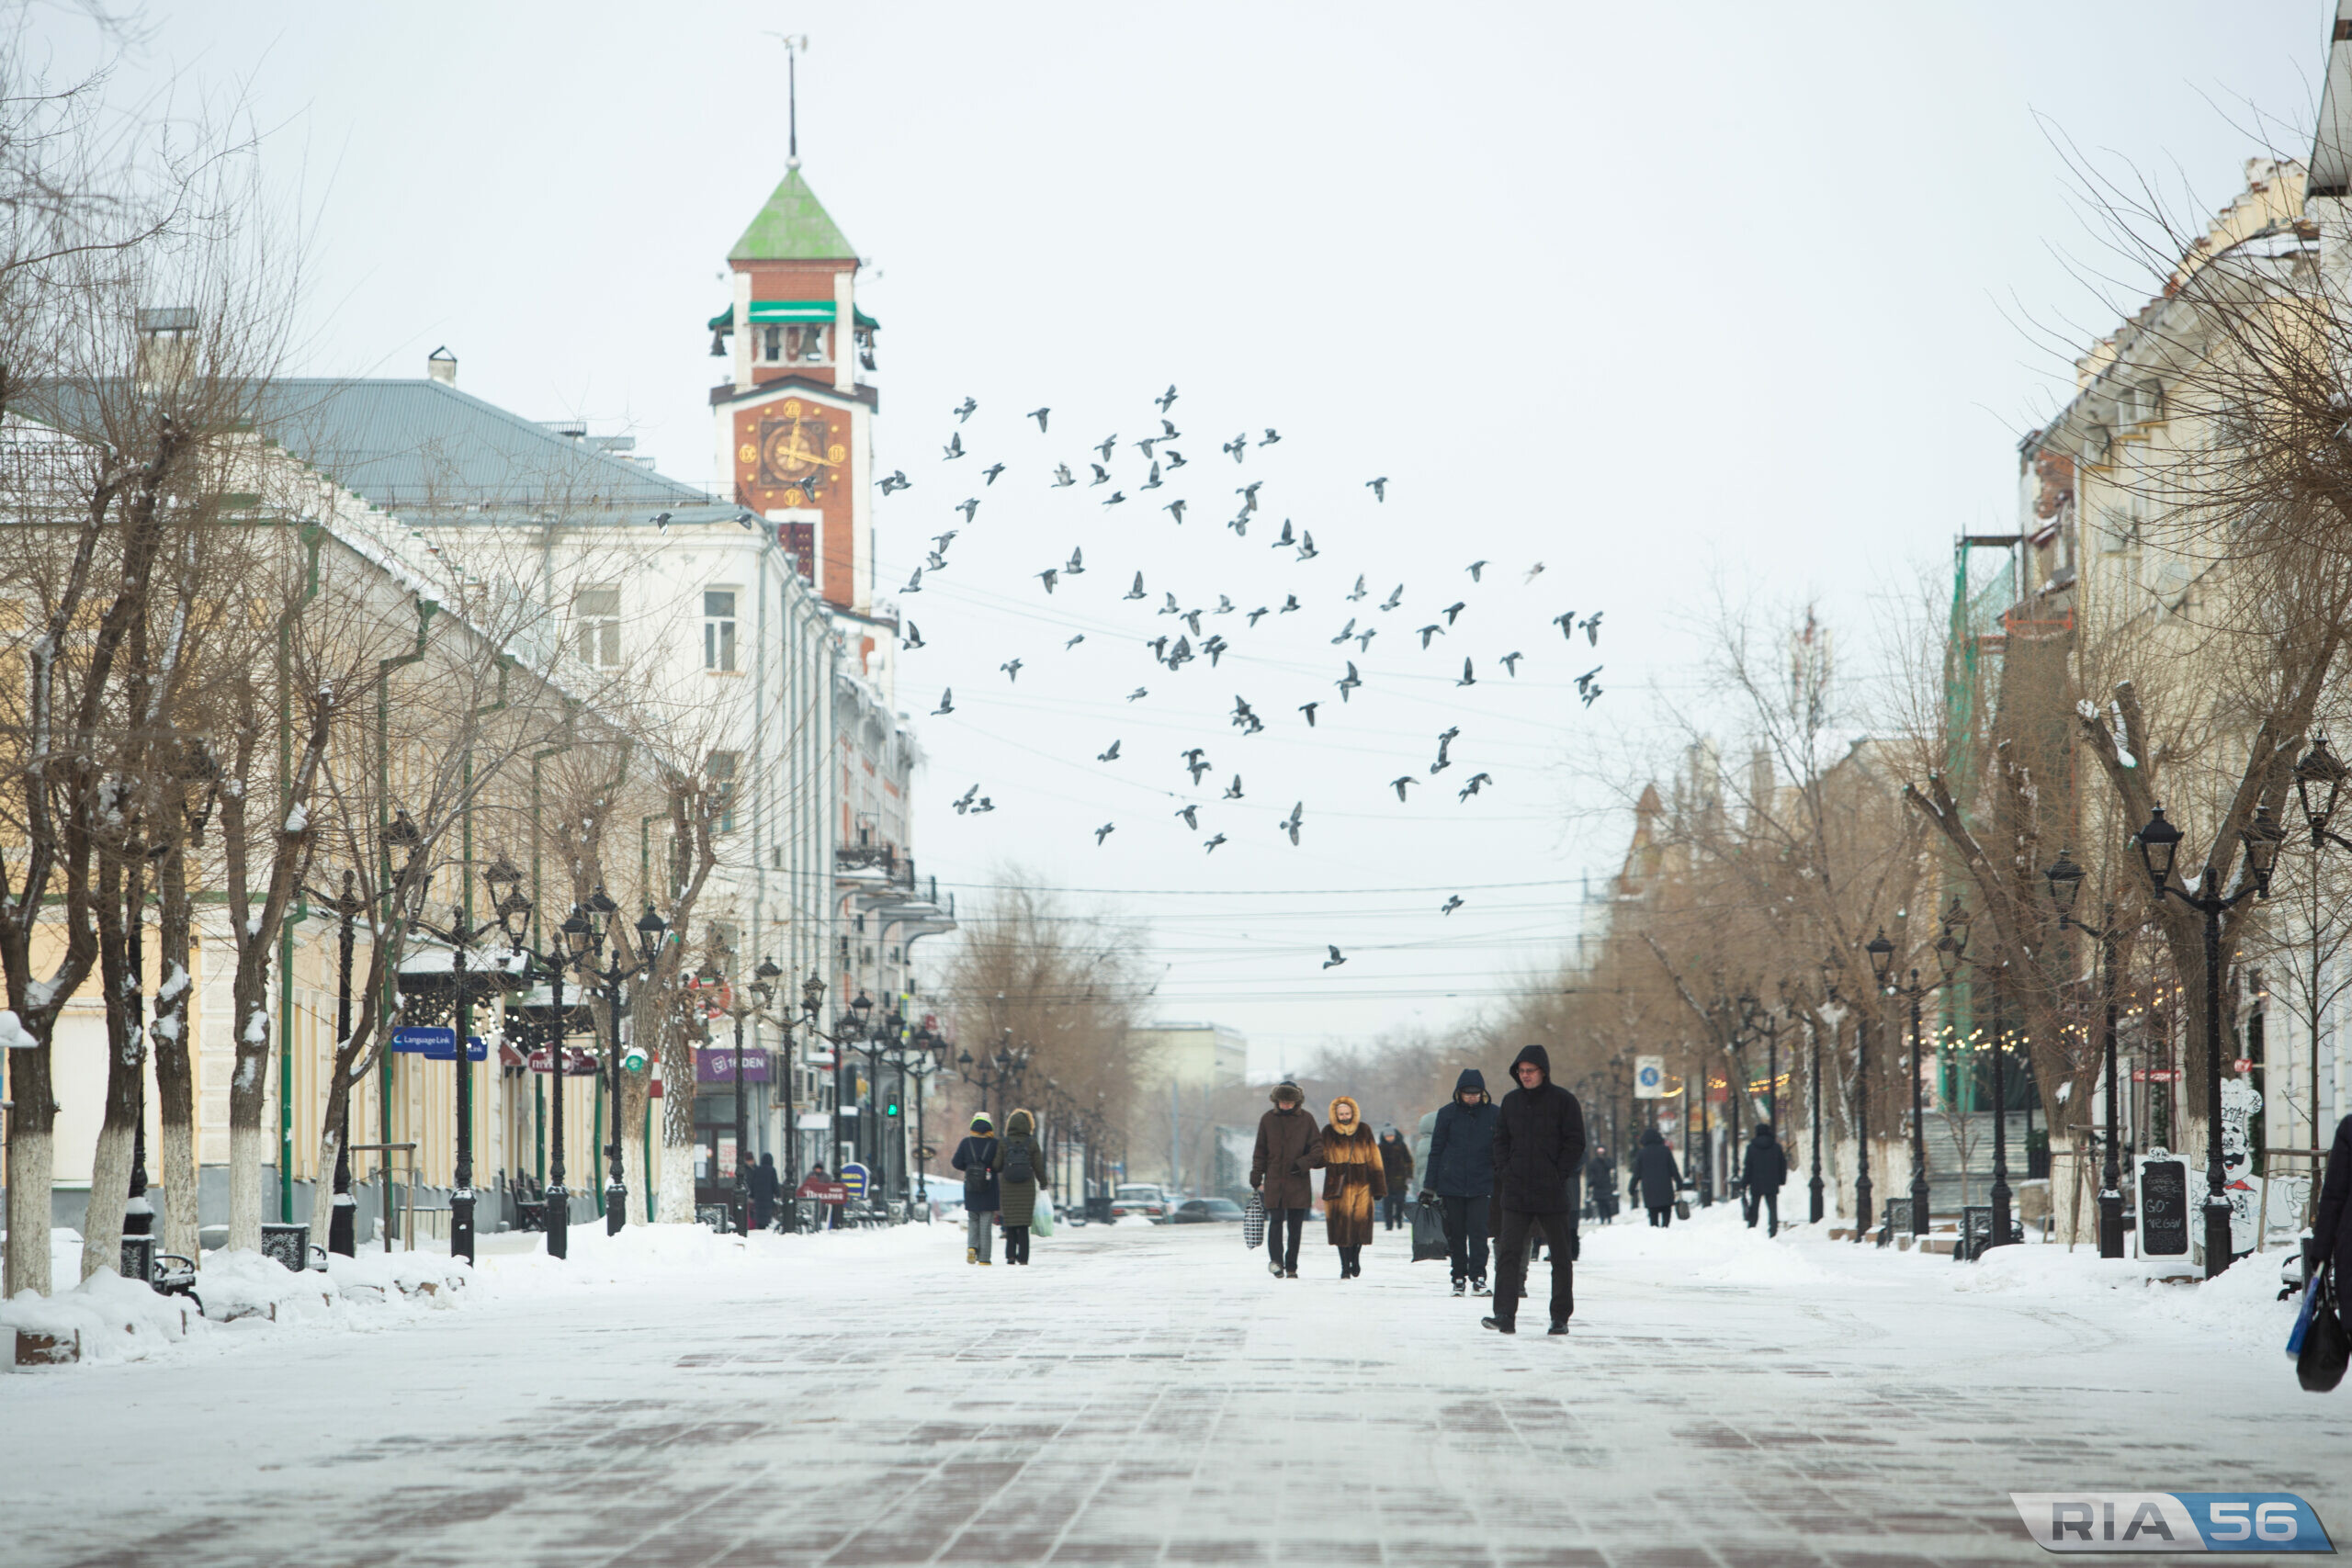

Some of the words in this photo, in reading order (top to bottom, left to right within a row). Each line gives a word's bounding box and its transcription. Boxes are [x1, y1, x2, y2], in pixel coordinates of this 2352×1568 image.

[404, 1036, 435, 1045] Language
[436, 1036, 450, 1044] Link
[742, 1057, 763, 1067] DEN
